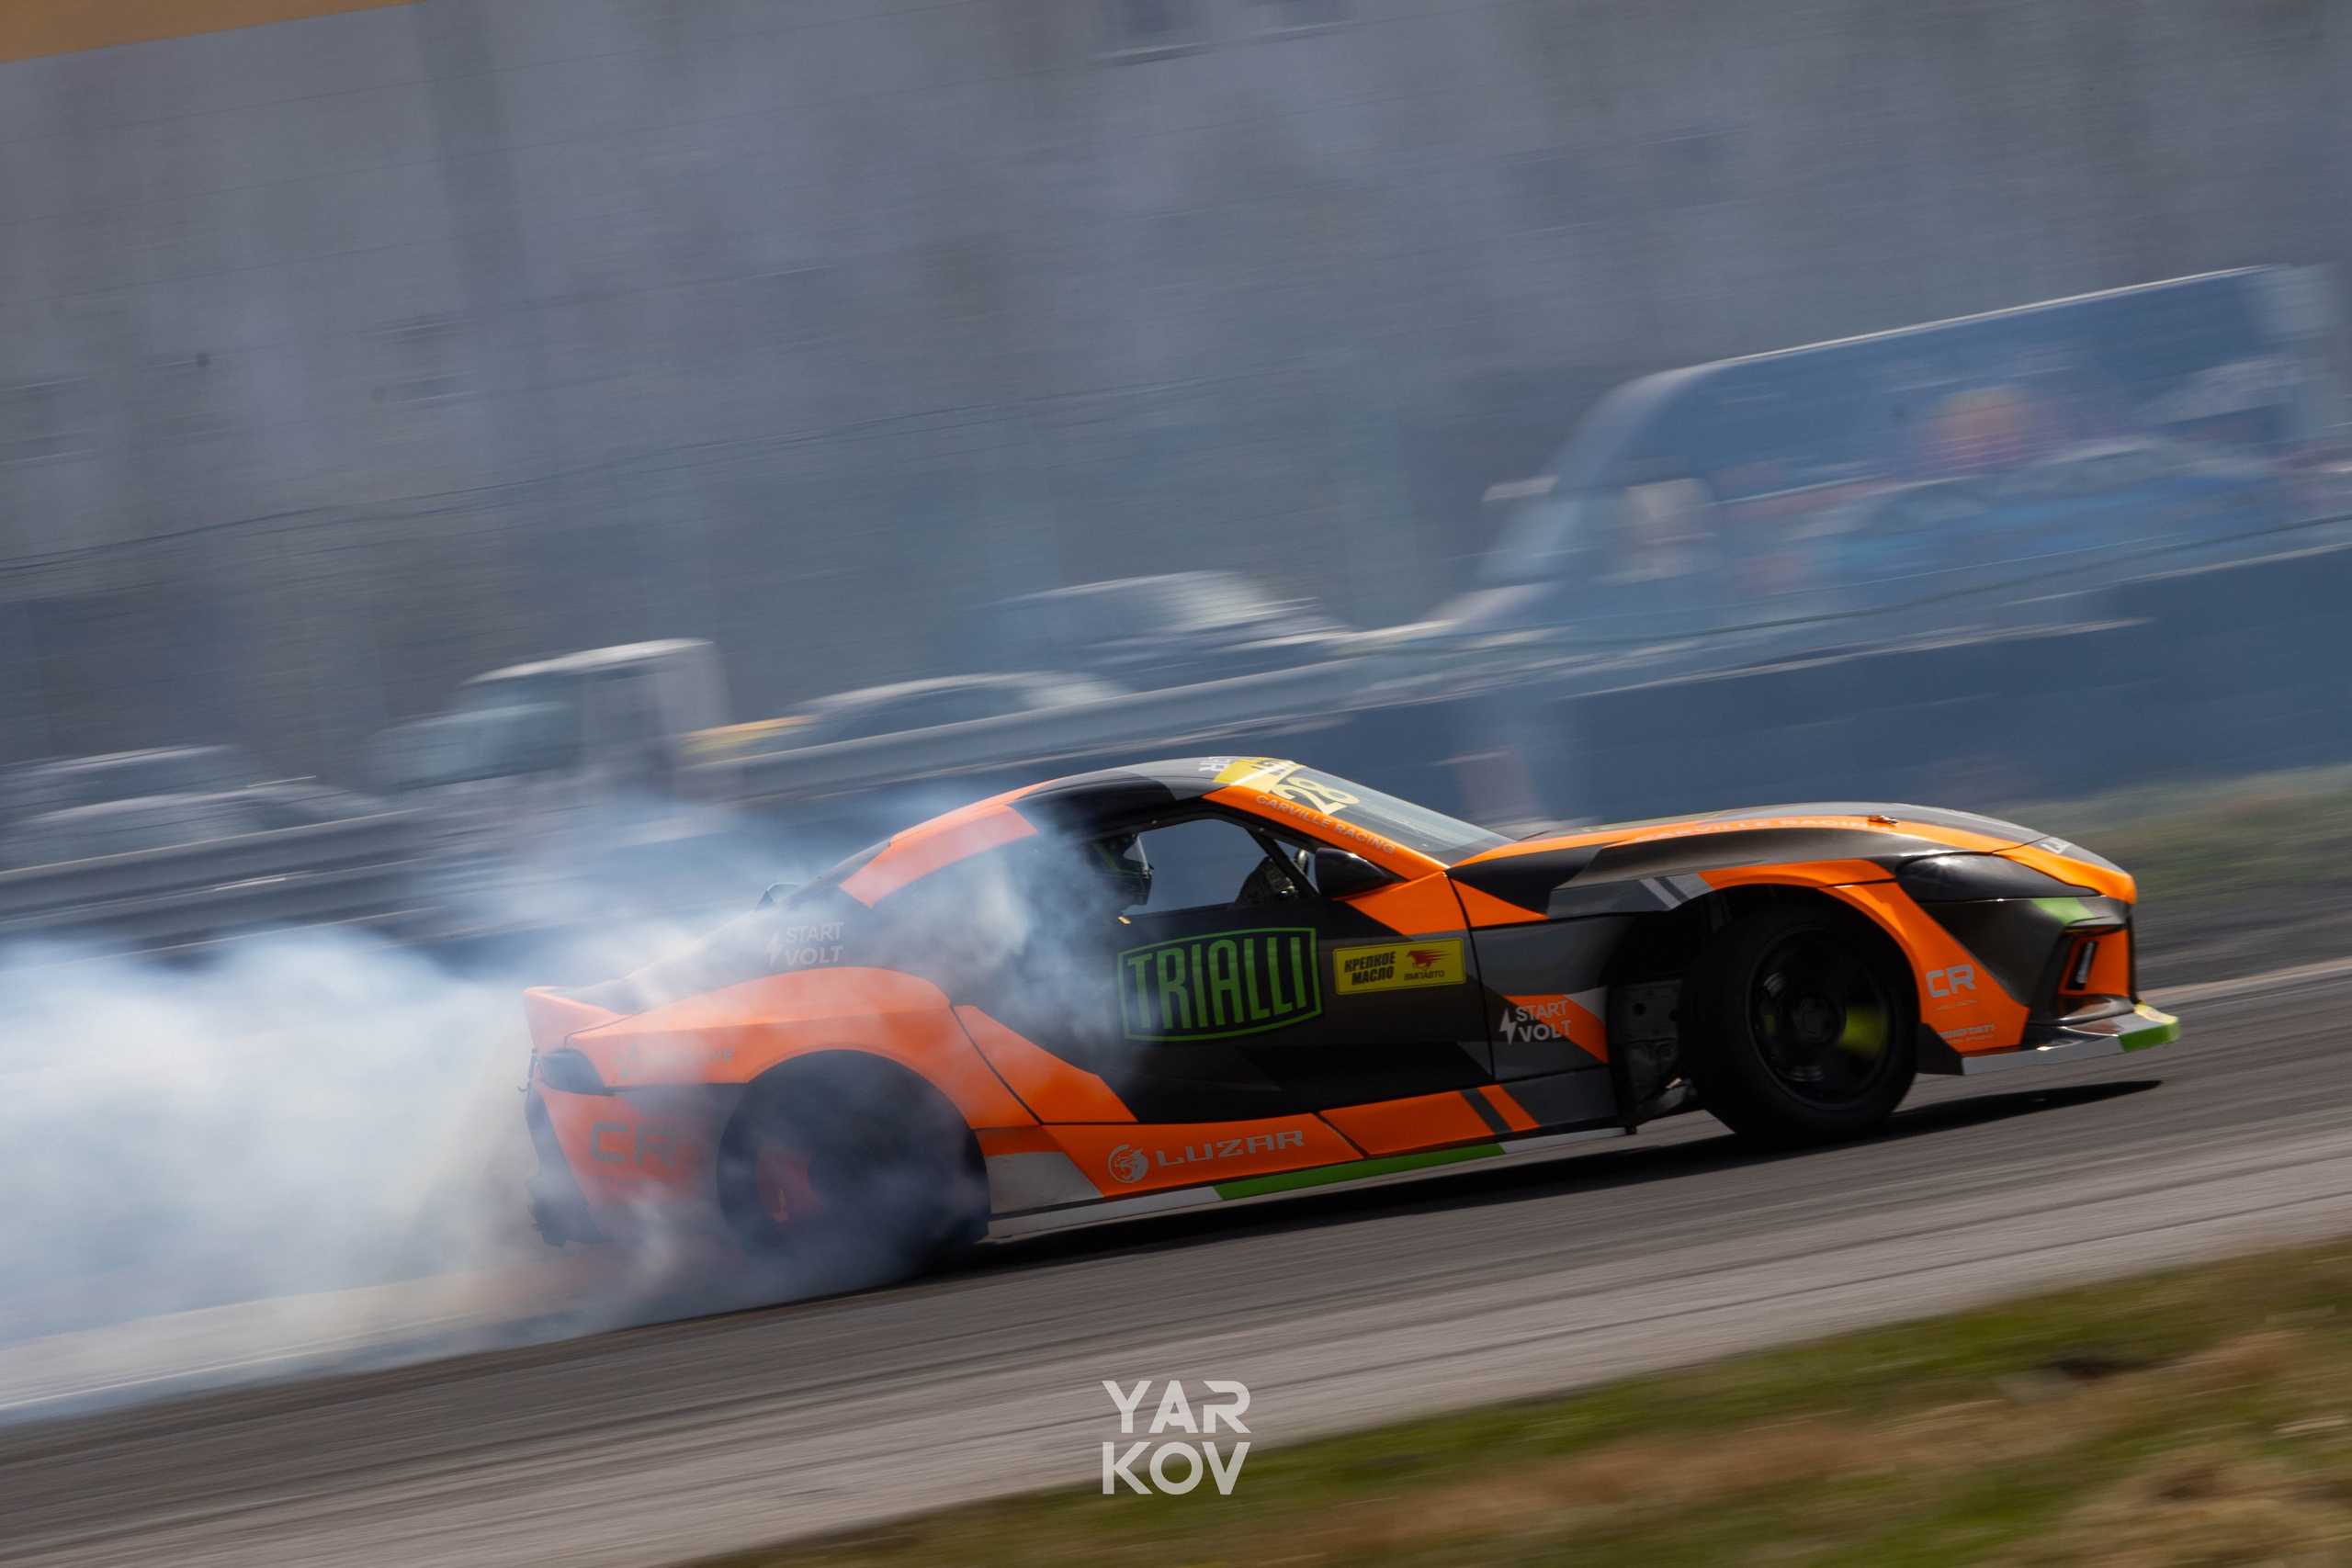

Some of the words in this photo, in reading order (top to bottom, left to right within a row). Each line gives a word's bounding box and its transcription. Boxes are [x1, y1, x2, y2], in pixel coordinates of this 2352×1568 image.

[1272, 776, 1360, 816] 28
[1255, 795, 1331, 829] CARVILLE
[1333, 823, 1396, 854] RACING
[786, 921, 844, 944] START
[785, 945, 843, 966] VOLT
[1344, 951, 1396, 973] КРЕПКОЕ
[1127, 937, 1306, 1029] TRIALLI
[1351, 965, 1394, 986] МАСЛО
[1926, 964, 1977, 998] CR
[1515, 1000, 1568, 1022] START
[1518, 1020, 1571, 1043] VOLT
[590, 1121, 678, 1167] CR
[1156, 1130, 1305, 1167] LUZAR
